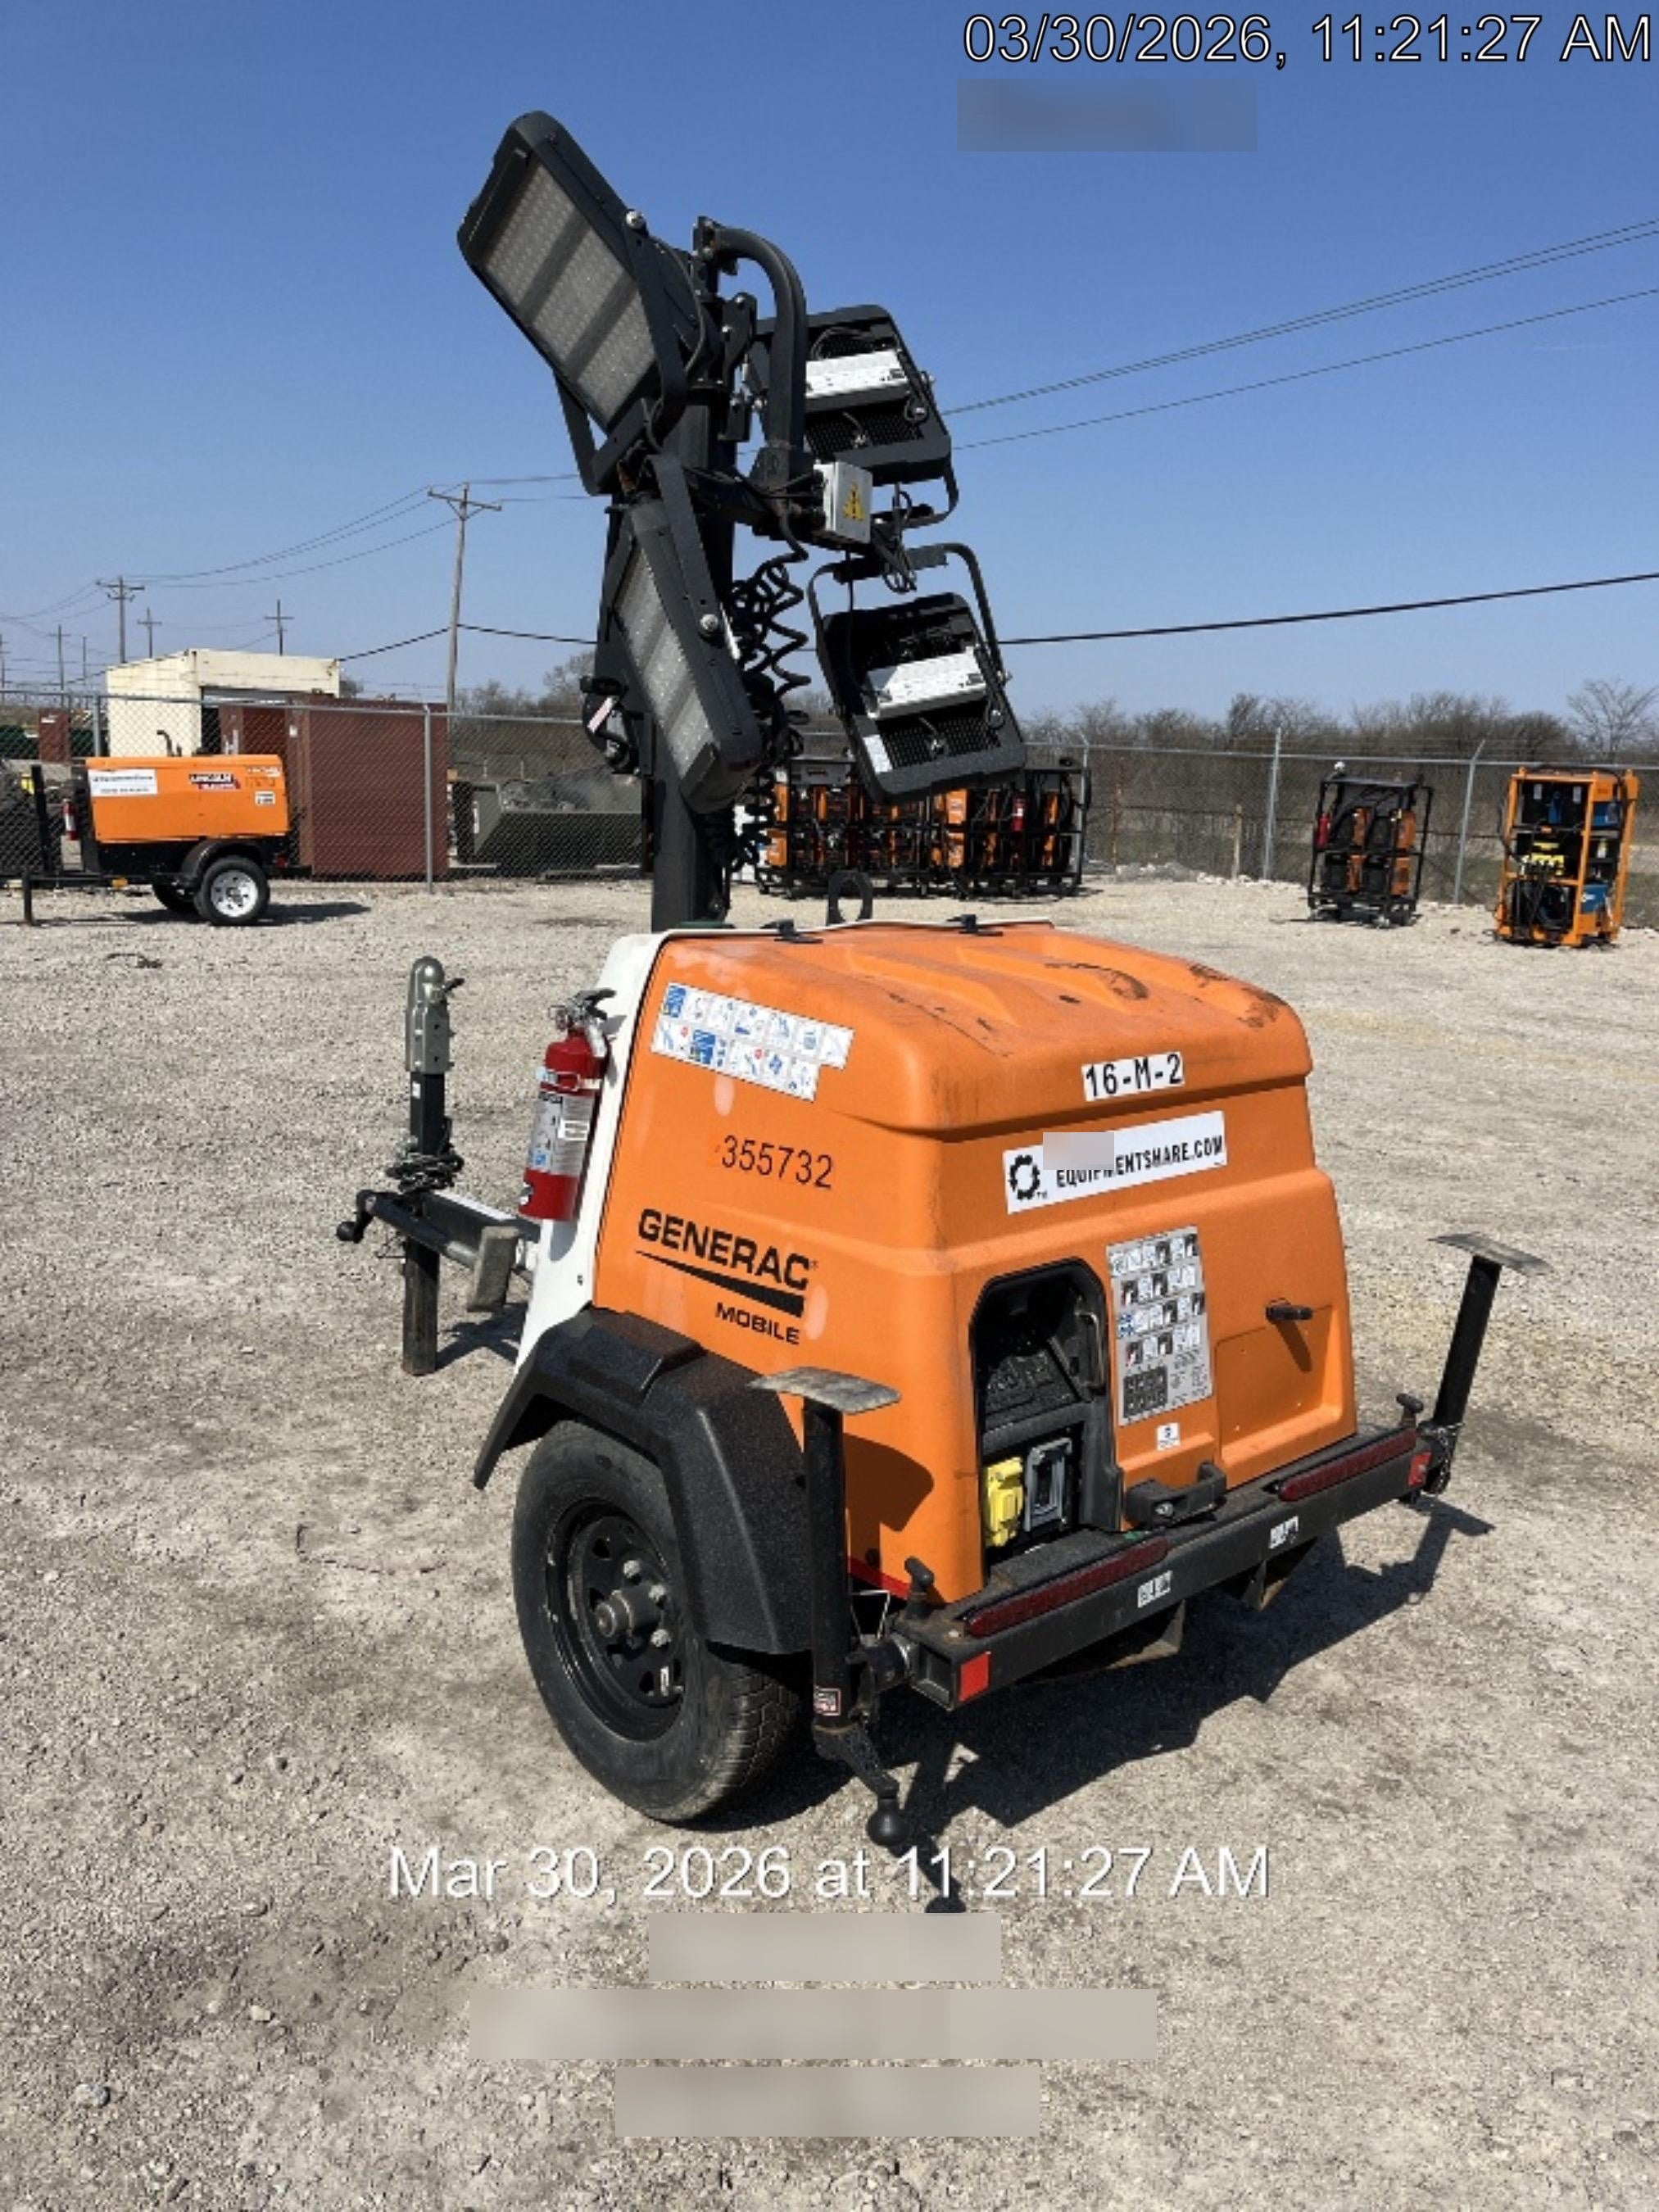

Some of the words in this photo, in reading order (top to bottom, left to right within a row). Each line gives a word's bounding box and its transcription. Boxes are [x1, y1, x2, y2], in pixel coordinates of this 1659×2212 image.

[1085, 1053, 1182, 1097] 16-M-2
[722, 1134, 833, 1189] 355732
[637, 1208, 810, 1291] GENERAC
[715, 1302, 800, 1344] MOBILE
